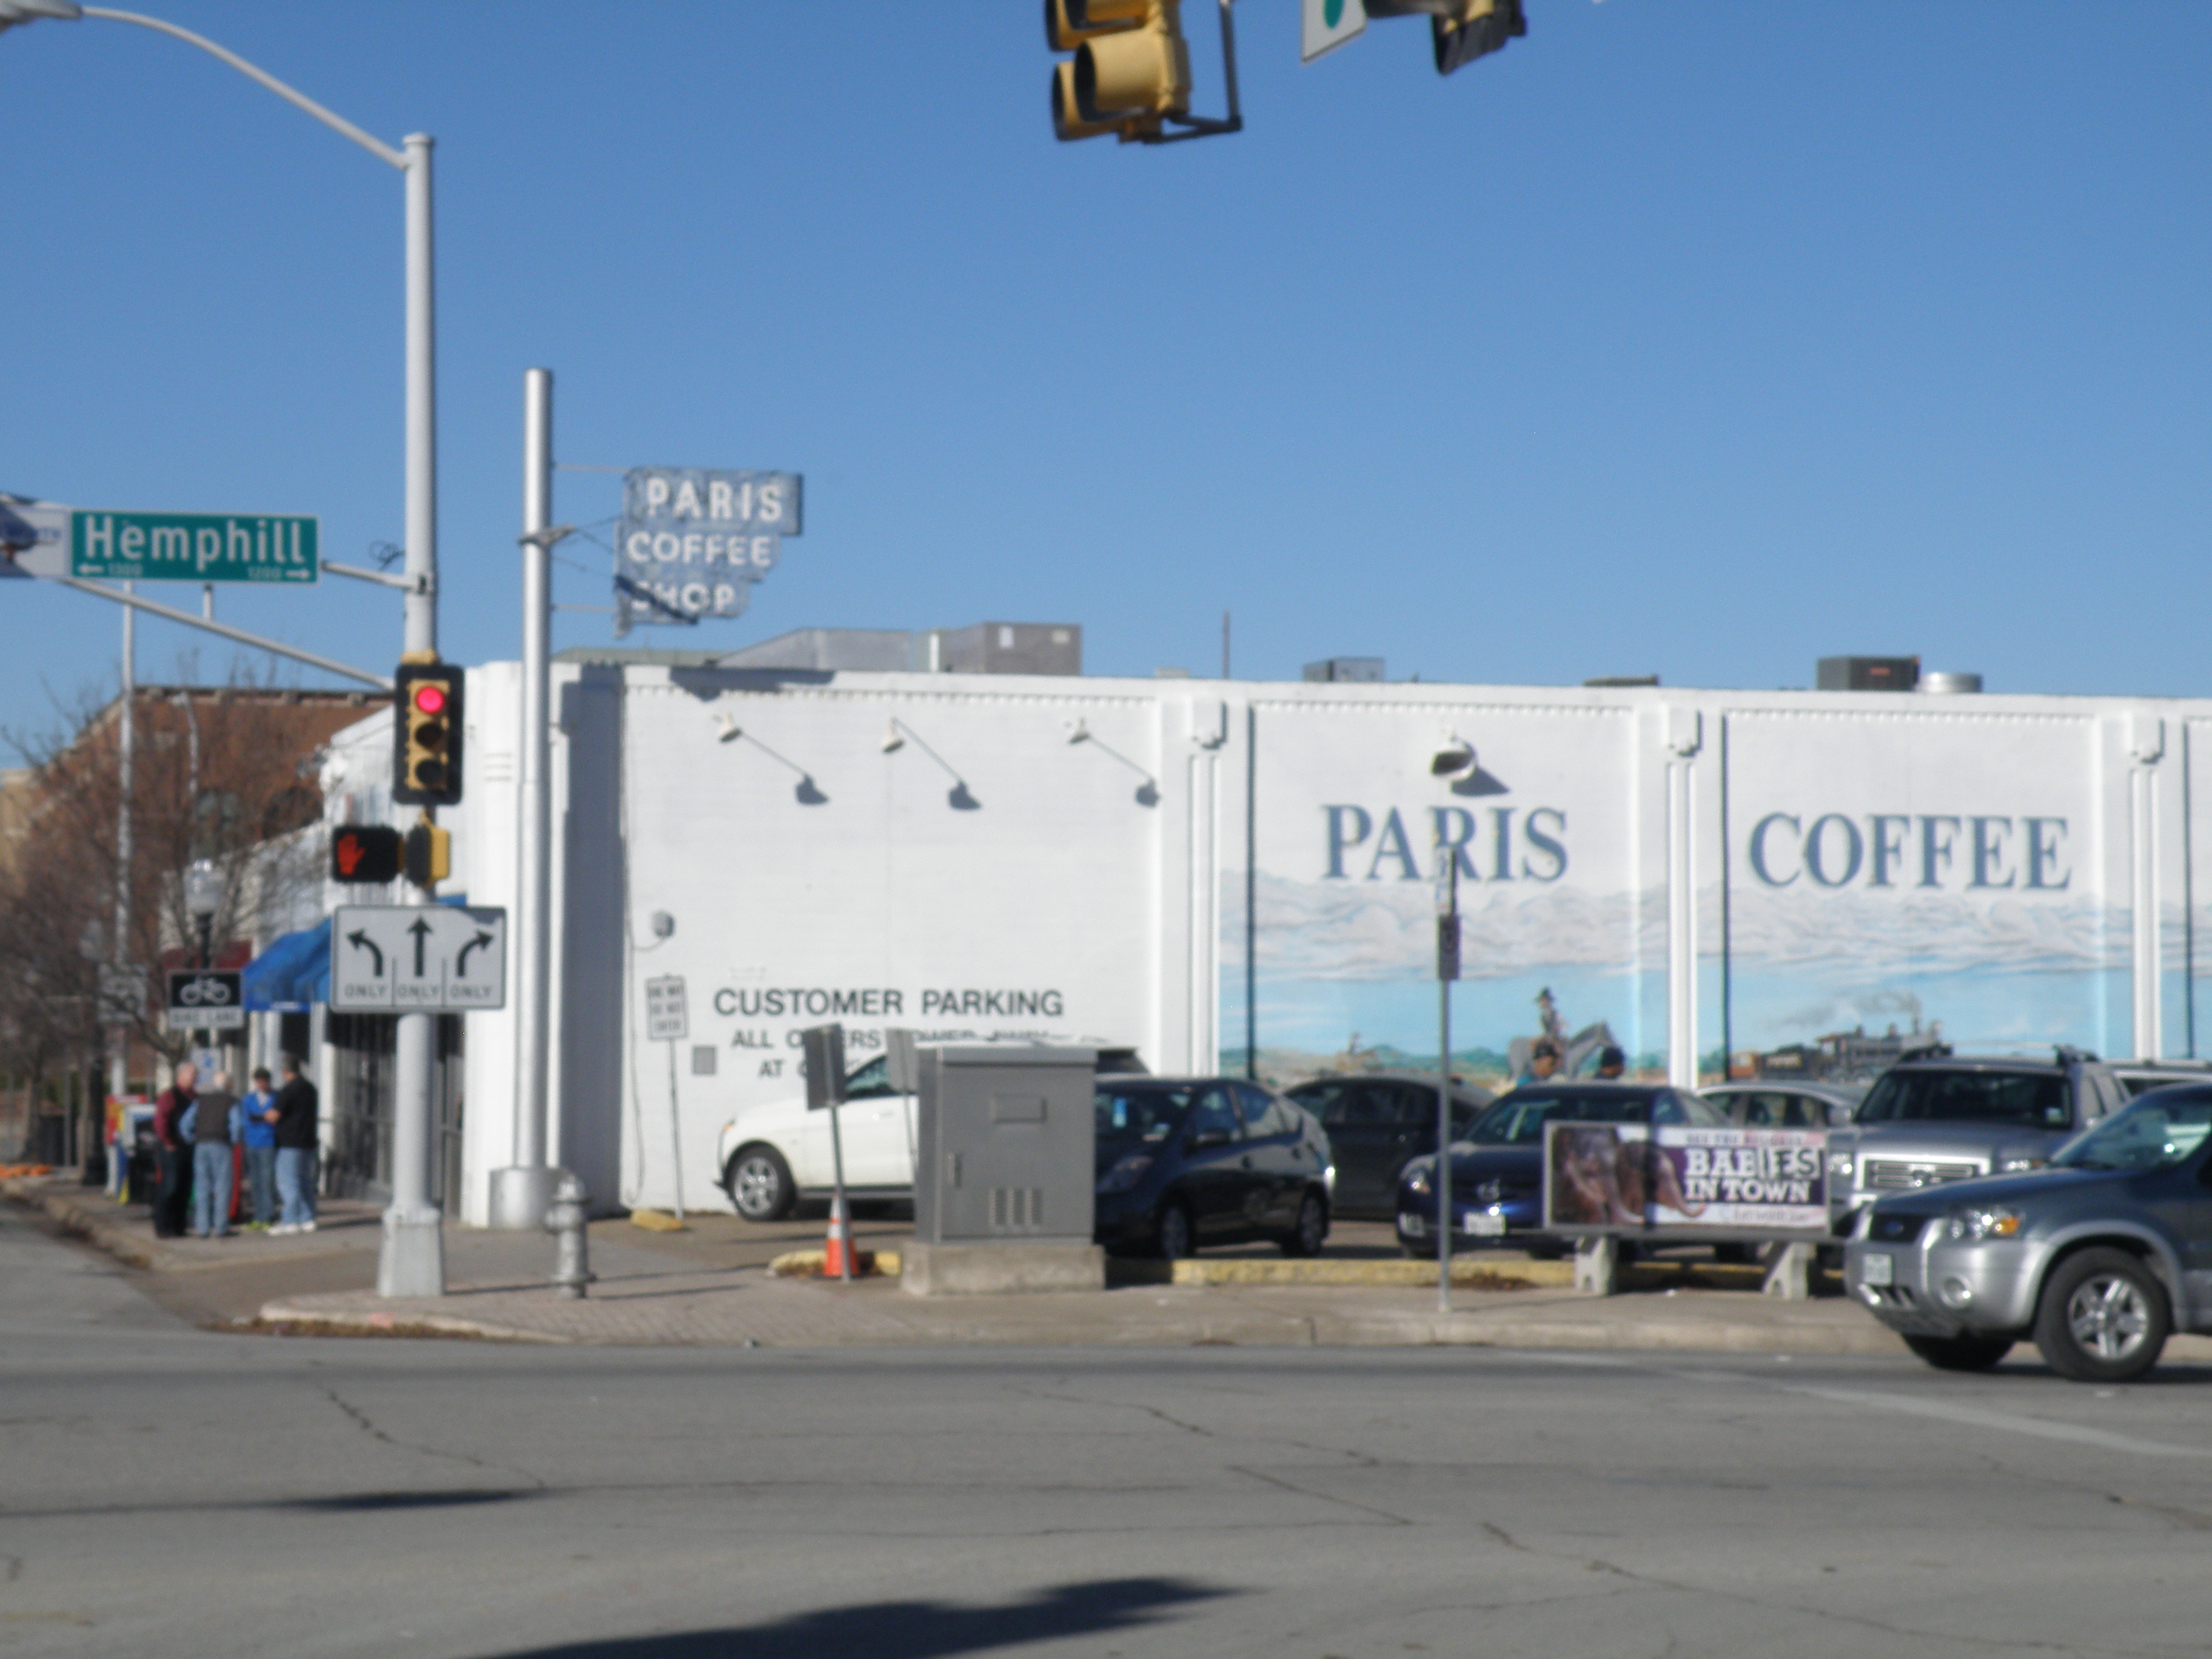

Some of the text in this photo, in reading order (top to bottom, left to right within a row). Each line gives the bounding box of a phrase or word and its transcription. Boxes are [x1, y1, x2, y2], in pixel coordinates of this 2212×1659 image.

[646, 477, 783, 522] PARIS
[85, 514, 307, 573] Hemphill
[626, 531, 772, 567] COFFEE
[1321, 804, 2073, 891] PARIS COFFEE
[344, 984, 386, 998] ONLY
[396, 984, 441, 998] ONLY
[449, 984, 493, 999] ONLY
[714, 987, 1065, 1017] CUSTOMER PARKING
[730, 1030, 775, 1049] ALL
[786, 1029, 882, 1049] ORS
[758, 1059, 785, 1079] AT
[1684, 1147, 1819, 1179] BABIES
[1684, 1179, 1811, 1203] IN TOWN
